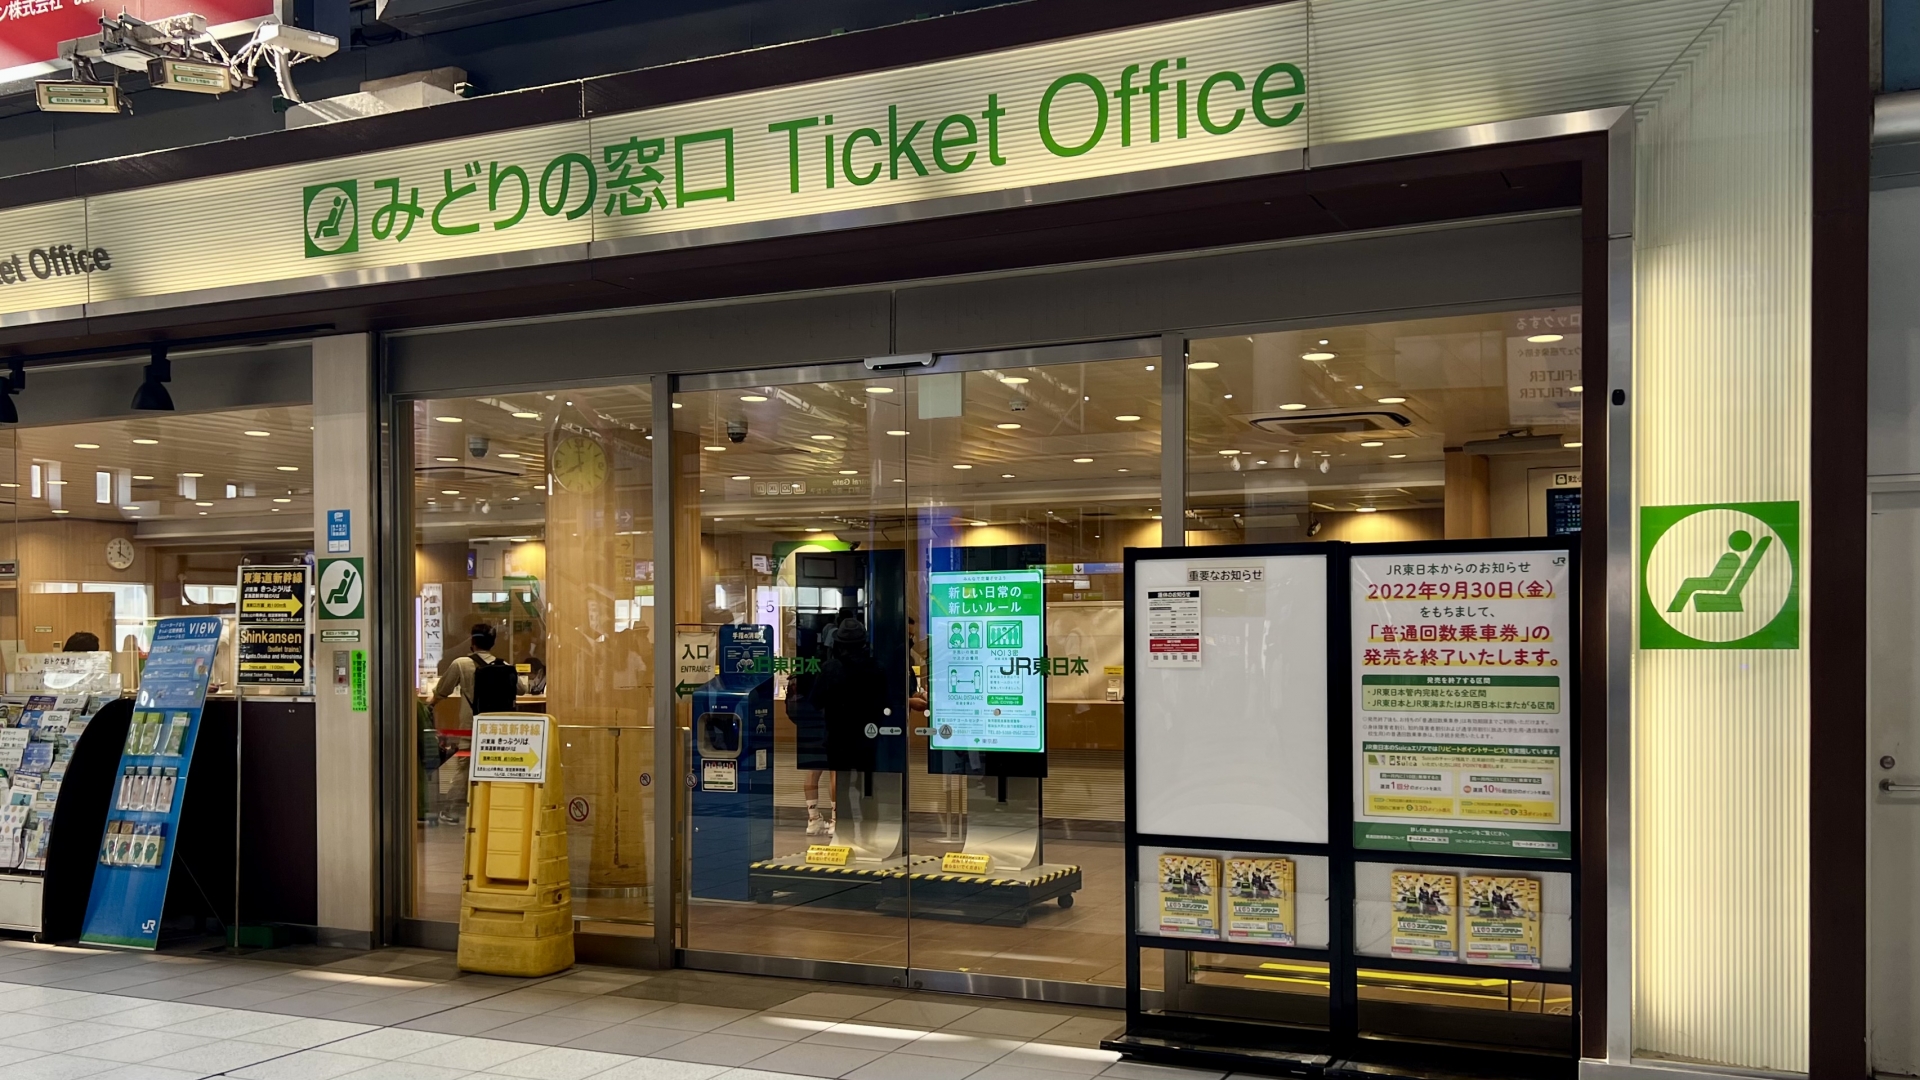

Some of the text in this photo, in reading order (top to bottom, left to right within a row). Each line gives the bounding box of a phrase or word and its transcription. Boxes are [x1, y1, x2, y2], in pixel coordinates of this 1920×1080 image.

[372, 57, 1306, 242] みどりの窓口 Ticket Office
[0, 244, 111, 284] et Office
[1188, 570, 1263, 581] 重要なお知らせ
[1386, 562, 1531, 576] JR東日本からのお知らせ
[243, 572, 303, 584] 東海道新幹線
[948, 585, 1022, 600] 新しい日常の
[1368, 580, 1554, 600] 2022年9月30日(金)
[948, 601, 1022, 614] 新しいルール
[1420, 606, 1496, 618] をもちまして、
[240, 630, 301, 644] Shinkansen
[1370, 624, 1550, 643] 「普通回数乗車券」の
[682, 644, 709, 660] 入口
[1363, 648, 1559, 667] 発売を終了いたします。
[681, 665, 711, 673] ENTRANCE
[744, 656, 822, 675] JR東日本
[1000, 656, 1089, 676] JR東日本
[1427, 677, 1491, 685] 発売を終了する区間
[479, 723, 541, 736] 東海道新幹線
[142, 919, 157, 931] JR
